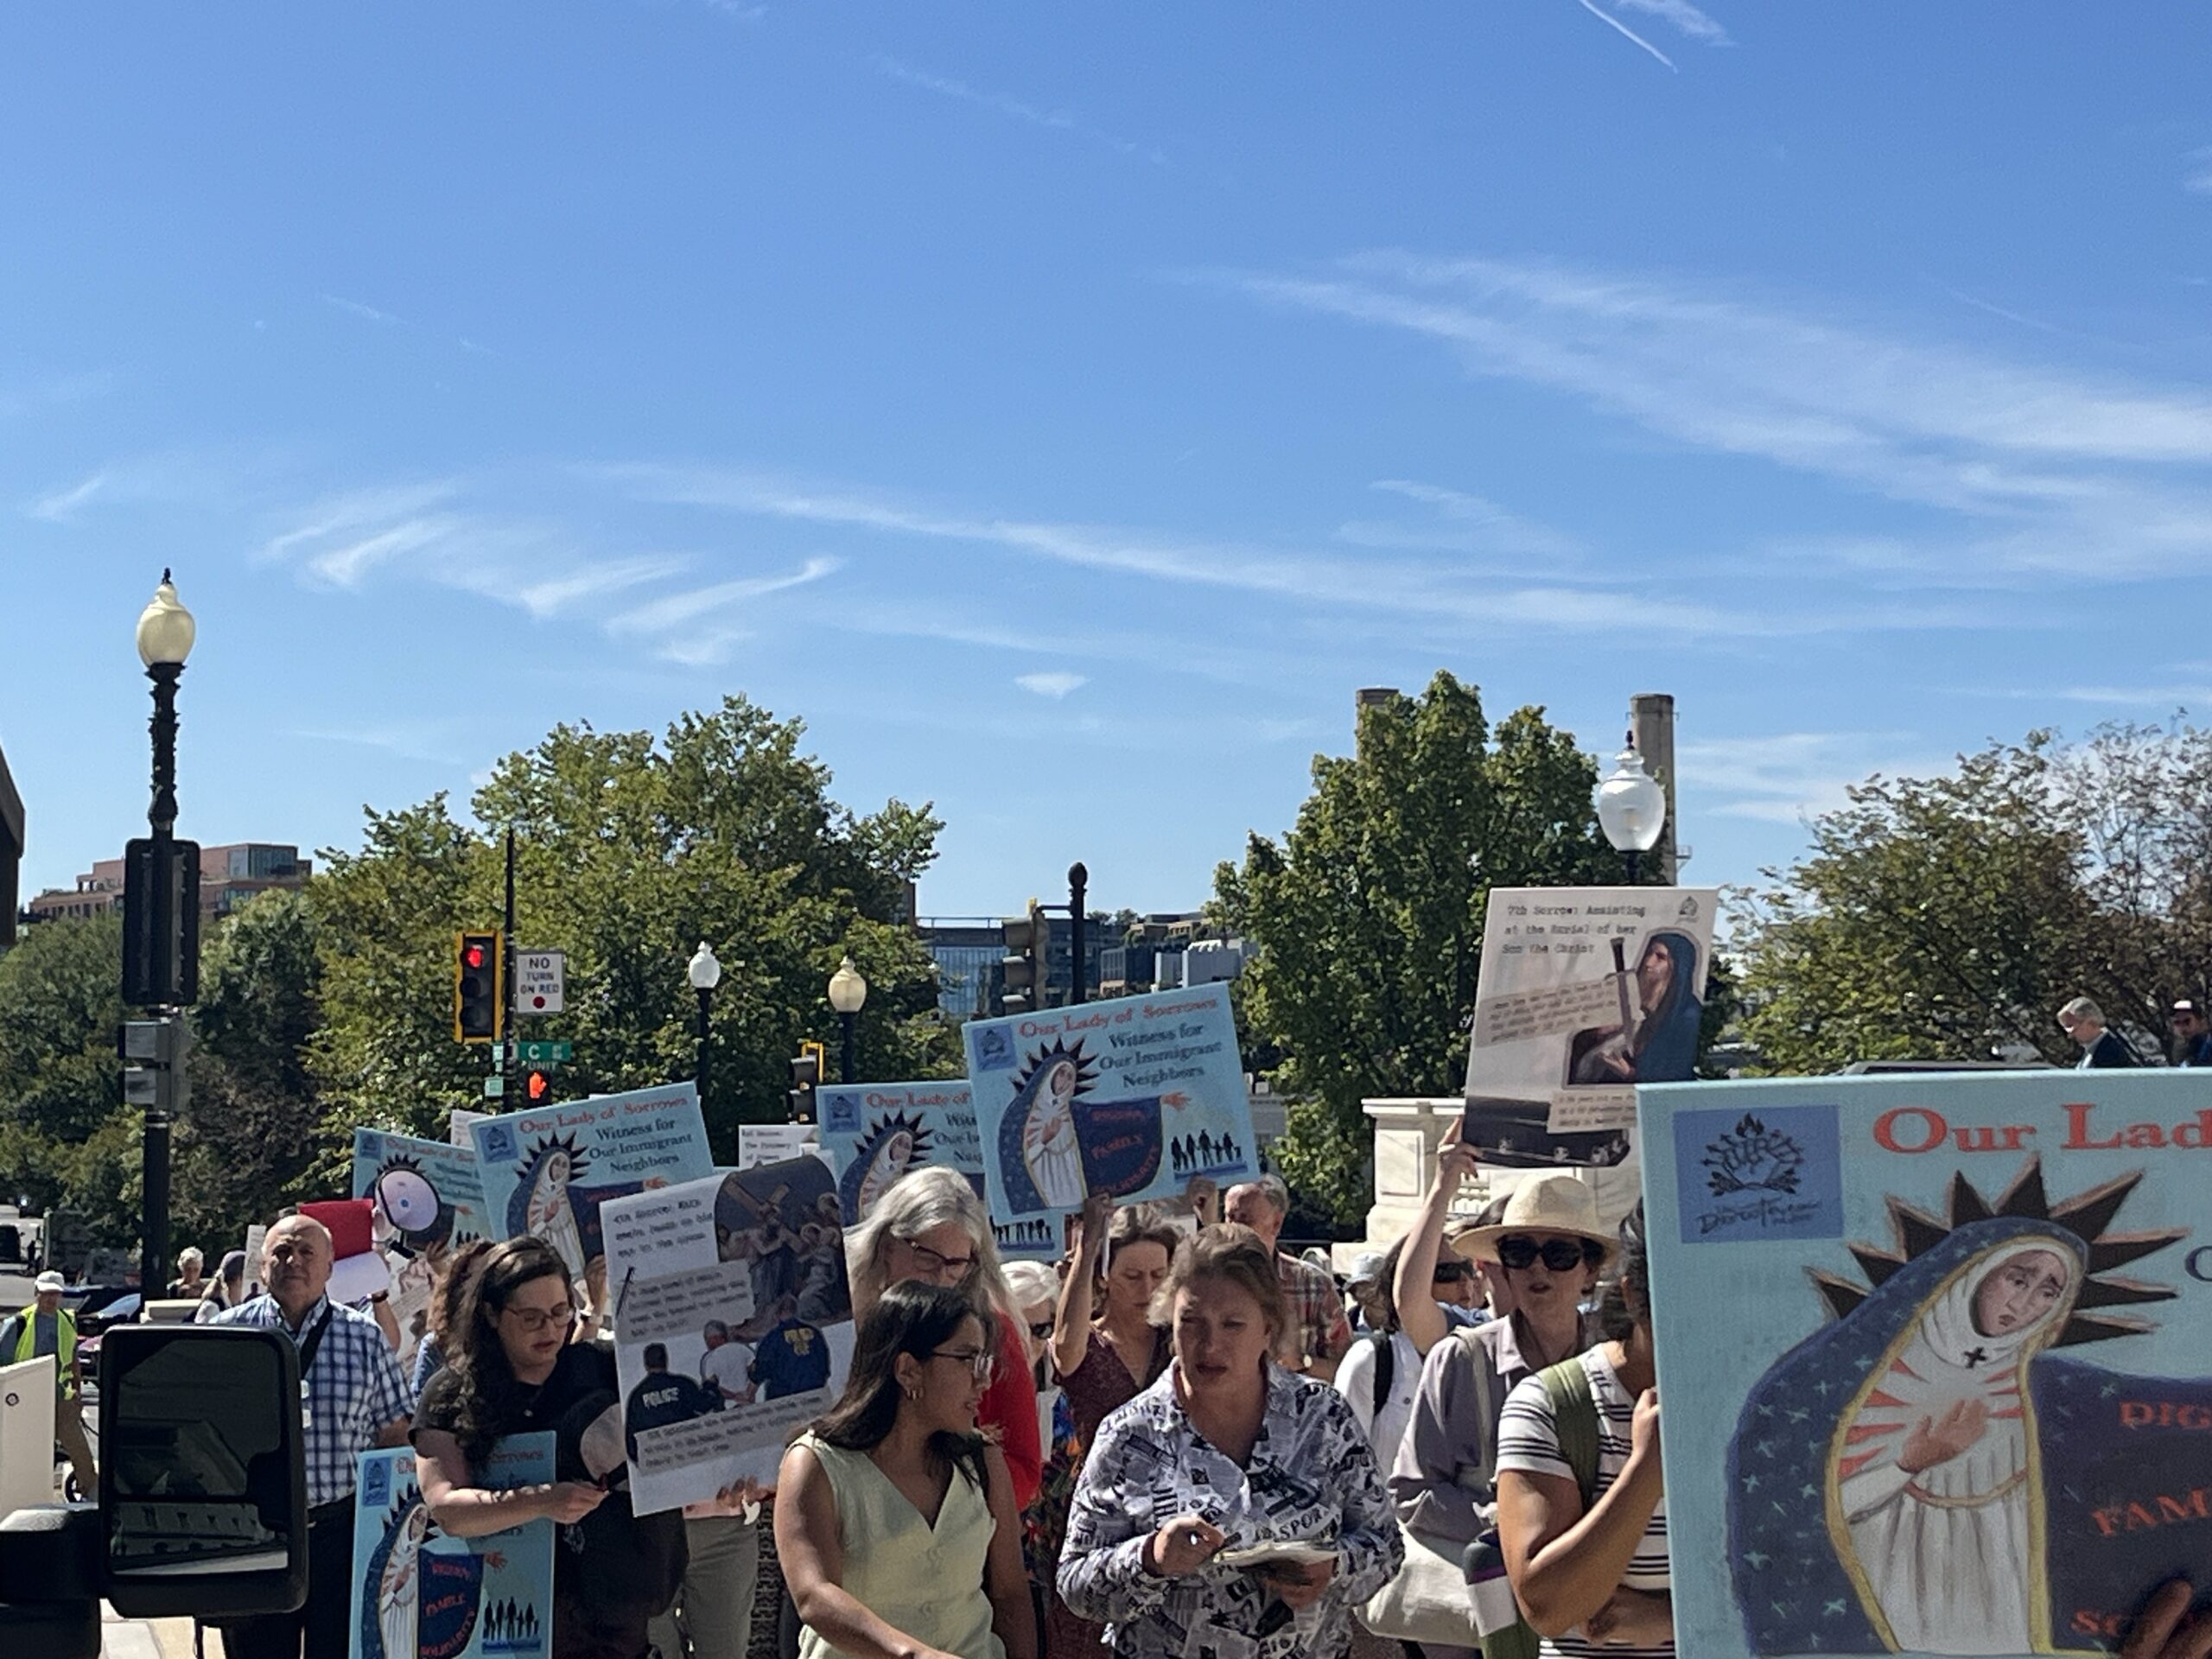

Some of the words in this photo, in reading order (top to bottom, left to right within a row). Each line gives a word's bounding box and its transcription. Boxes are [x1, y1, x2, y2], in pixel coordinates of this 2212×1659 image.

[529, 957, 550, 969] NO
[525, 970, 555, 982] TURN
[520, 984, 535, 994] ON
[538, 983, 560, 994] RED
[1019, 1020, 1059, 1039] Our
[1064, 1014, 1111, 1033] Lady
[1115, 1007, 1134, 1024] of
[1109, 1027, 1177, 1049] Witness
[1179, 1022, 1205, 1038] for
[527, 1044, 541, 1060] C
[1099, 1053, 1132, 1071] Our
[1135, 1041, 1223, 1065] Immigrant
[1123, 1065, 1205, 1088] Neighbors
[867, 1091, 901, 1109] Our
[519, 1119, 551, 1135] Our
[556, 1109, 596, 1128] Lady
[600, 1108, 618, 1121] of
[596, 1122, 652, 1141] Witness
[655, 1117, 677, 1131] for
[1872, 1105, 2037, 1154] Our
[588, 1145, 618, 1160] Our
[620, 1133, 693, 1156] Immigrant
[609, 1154, 680, 1175] Neighbors
